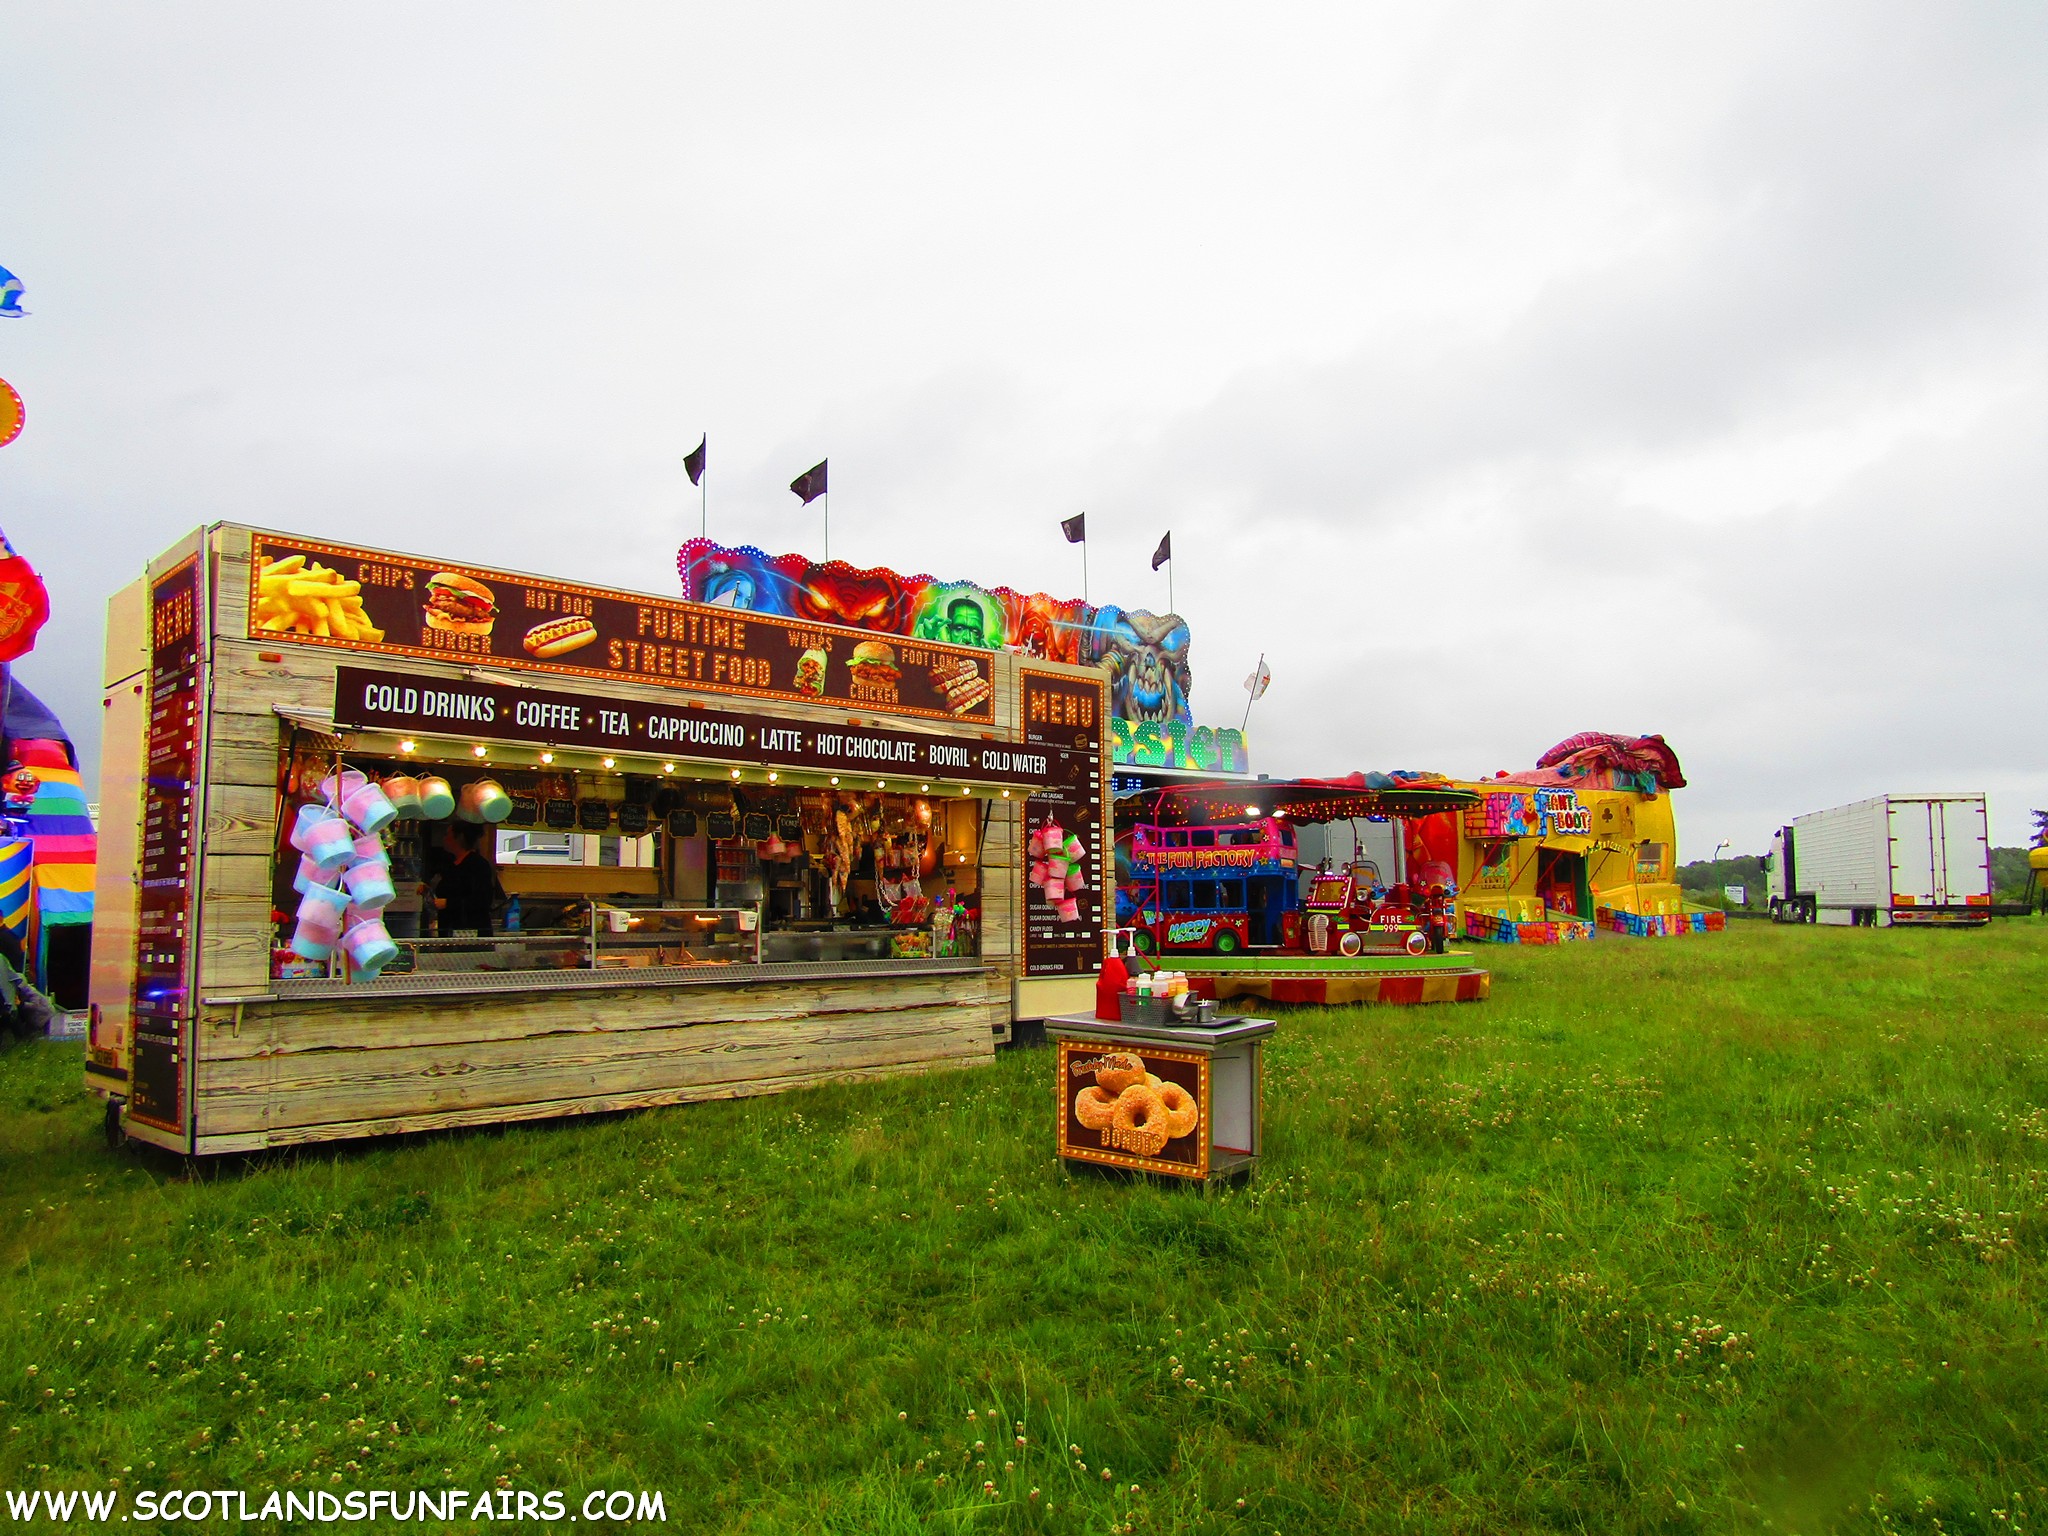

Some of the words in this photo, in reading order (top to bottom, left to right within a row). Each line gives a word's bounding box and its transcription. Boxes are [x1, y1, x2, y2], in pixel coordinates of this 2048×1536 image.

[359, 563, 415, 590] CHIPS
[525, 589, 557, 611] HOT
[562, 594, 593, 617] DOG
[156, 587, 192, 651] MENU
[637, 605, 746, 650] FUNTIME
[422, 627, 492, 654] BURGER
[787, 630, 833, 652] WRAPS
[608, 638, 706, 679] STREET
[713, 652, 771, 687] FOOD
[901, 648, 929, 667] FOOT
[932, 653, 960, 670] LONG
[850, 683, 899, 704] CHICKEN
[1030, 689, 1093, 728] MENU
[365, 684, 418, 714] COLD
[422, 690, 495, 722] DRINKS
[516, 700, 581, 731] COFFEE
[599, 710, 630, 736] TEA
[648, 715, 744, 748] CAPPUCCINO
[760, 727, 802, 753] LATTE
[817, 733, 844, 756] HOT
[845, 735, 916, 763] CHOCOLATE
[929, 744, 970, 768] BOVRIL
[982, 750, 1010, 771] COLD
[1012, 753, 1047, 774] WATER
[1557, 811, 1588, 829] BOOT
[1167, 852, 1194, 870] FUN
[1195, 849, 1256, 869] FACTORY
[1168, 918, 1211, 941] HAPPY
[1380, 915, 1402, 924] FIRE
[1383, 924, 1400, 933] 999
[1174, 931, 1204, 943] DAYS
[1102, 1055, 1133, 1071] Made
[1101, 1127, 1161, 1155] DONUTS
